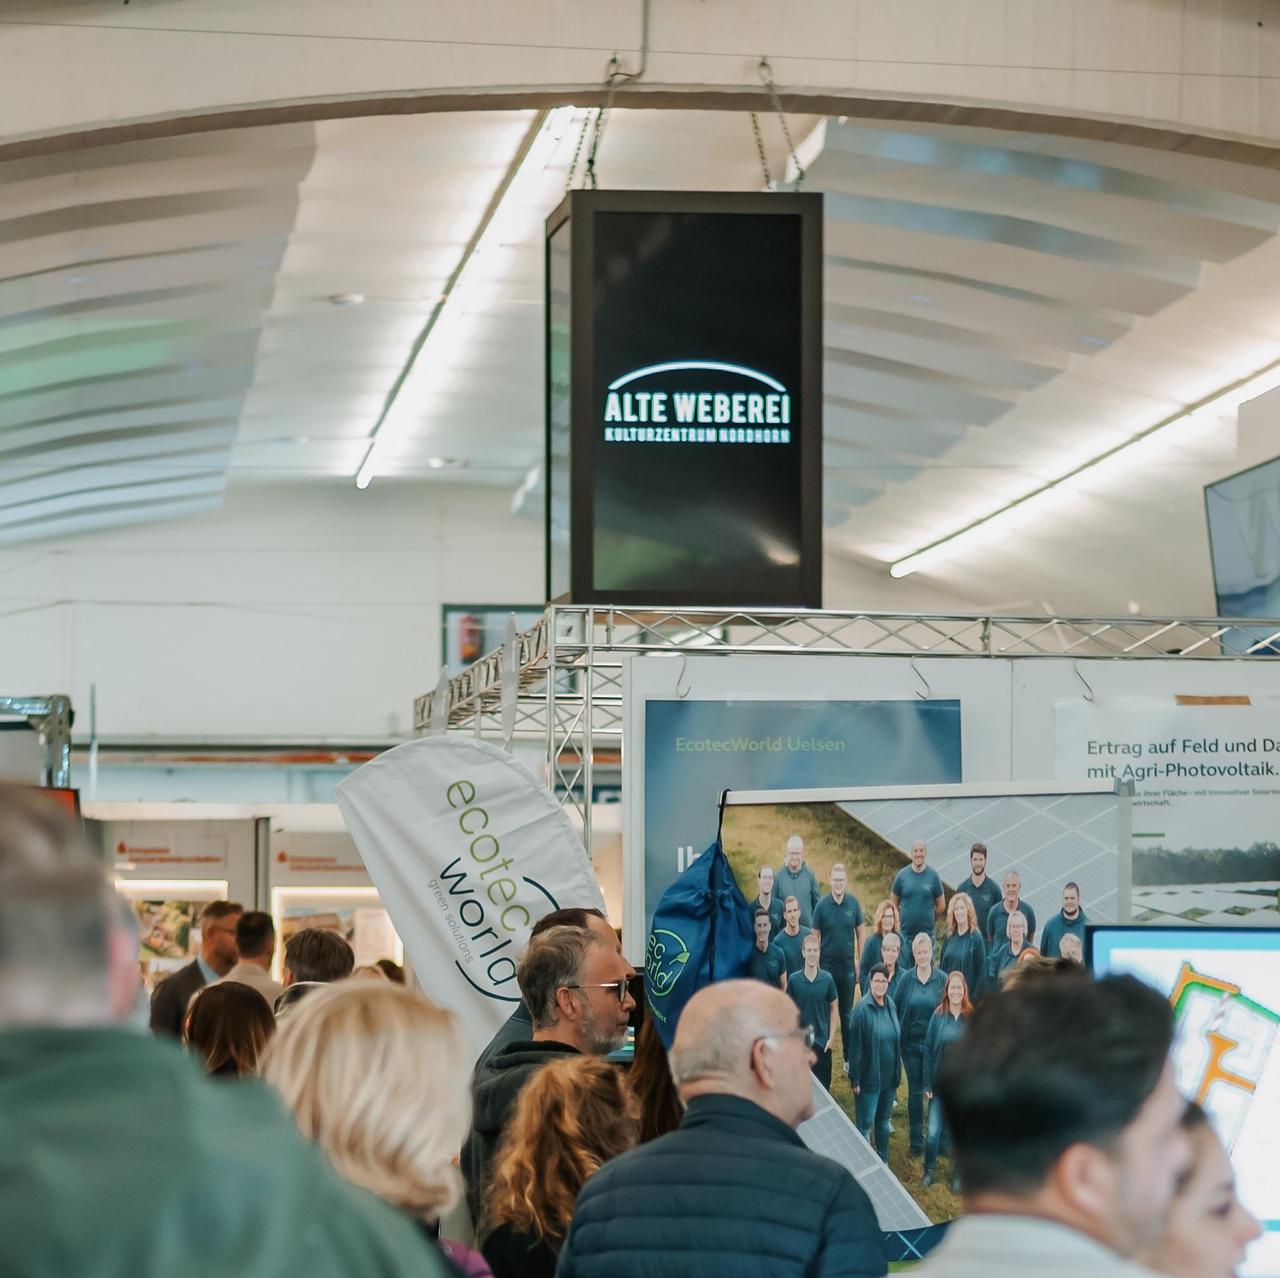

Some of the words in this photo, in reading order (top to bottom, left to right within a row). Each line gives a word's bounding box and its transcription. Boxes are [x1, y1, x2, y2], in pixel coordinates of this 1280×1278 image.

[604, 392, 668, 422] ALTE
[673, 393, 791, 424] WEBEREI
[604, 427, 717, 442] KULTURZENTRUM
[719, 429, 791, 443] NORDHORN
[675, 737, 783, 752] EcotecWorld
[787, 738, 846, 752] Uelsen
[1087, 740, 1143, 758] Ertrag
[1148, 739, 1177, 754] auf
[1182, 739, 1219, 754] Feld
[1224, 738, 1257, 753] und
[1087, 764, 1117, 779] mit
[1122, 762, 1280, 782] Agri-Photovoltaik.
[446, 780, 530, 932] ecotec
[427, 879, 449, 916] green
[444, 912, 474, 964] solutions
